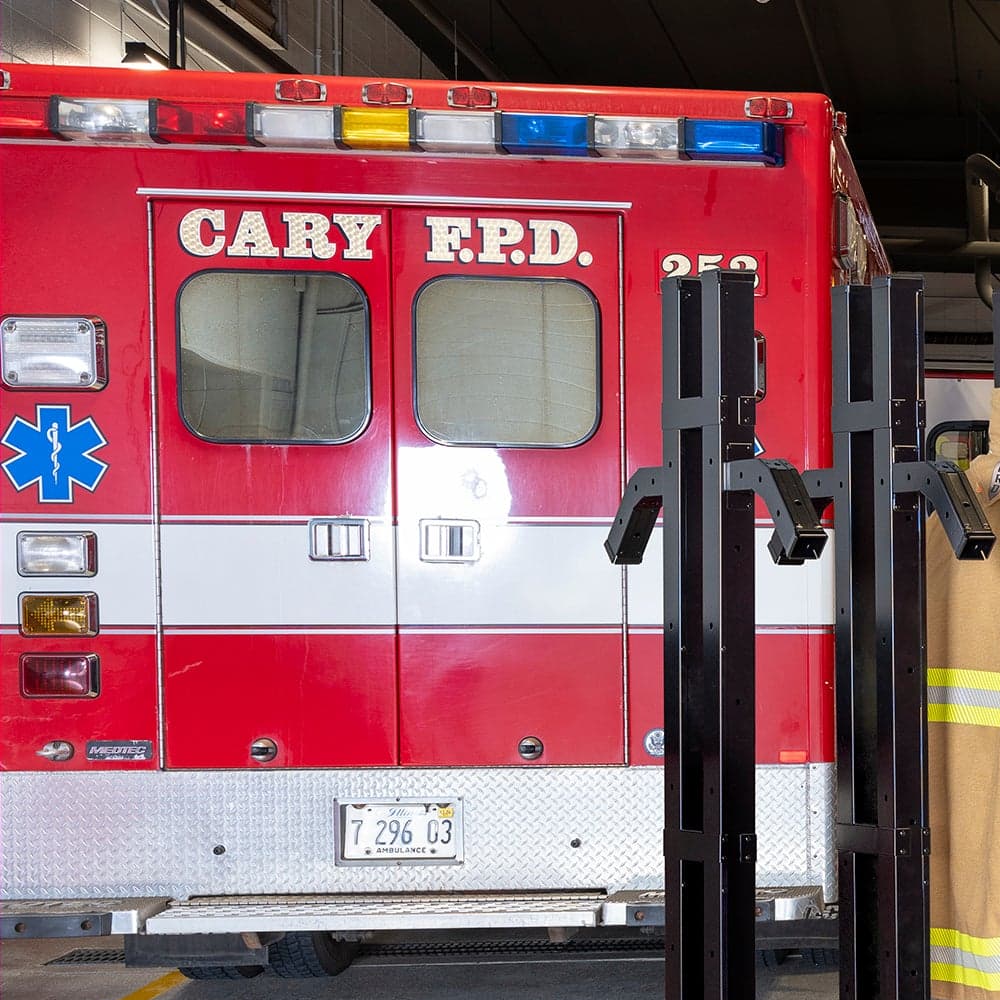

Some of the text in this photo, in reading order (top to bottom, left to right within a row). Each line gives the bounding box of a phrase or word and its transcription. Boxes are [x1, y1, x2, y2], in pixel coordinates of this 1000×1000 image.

[179, 208, 594, 267] CARY F.P.D.
[351, 819, 452, 845] 7 296 03
